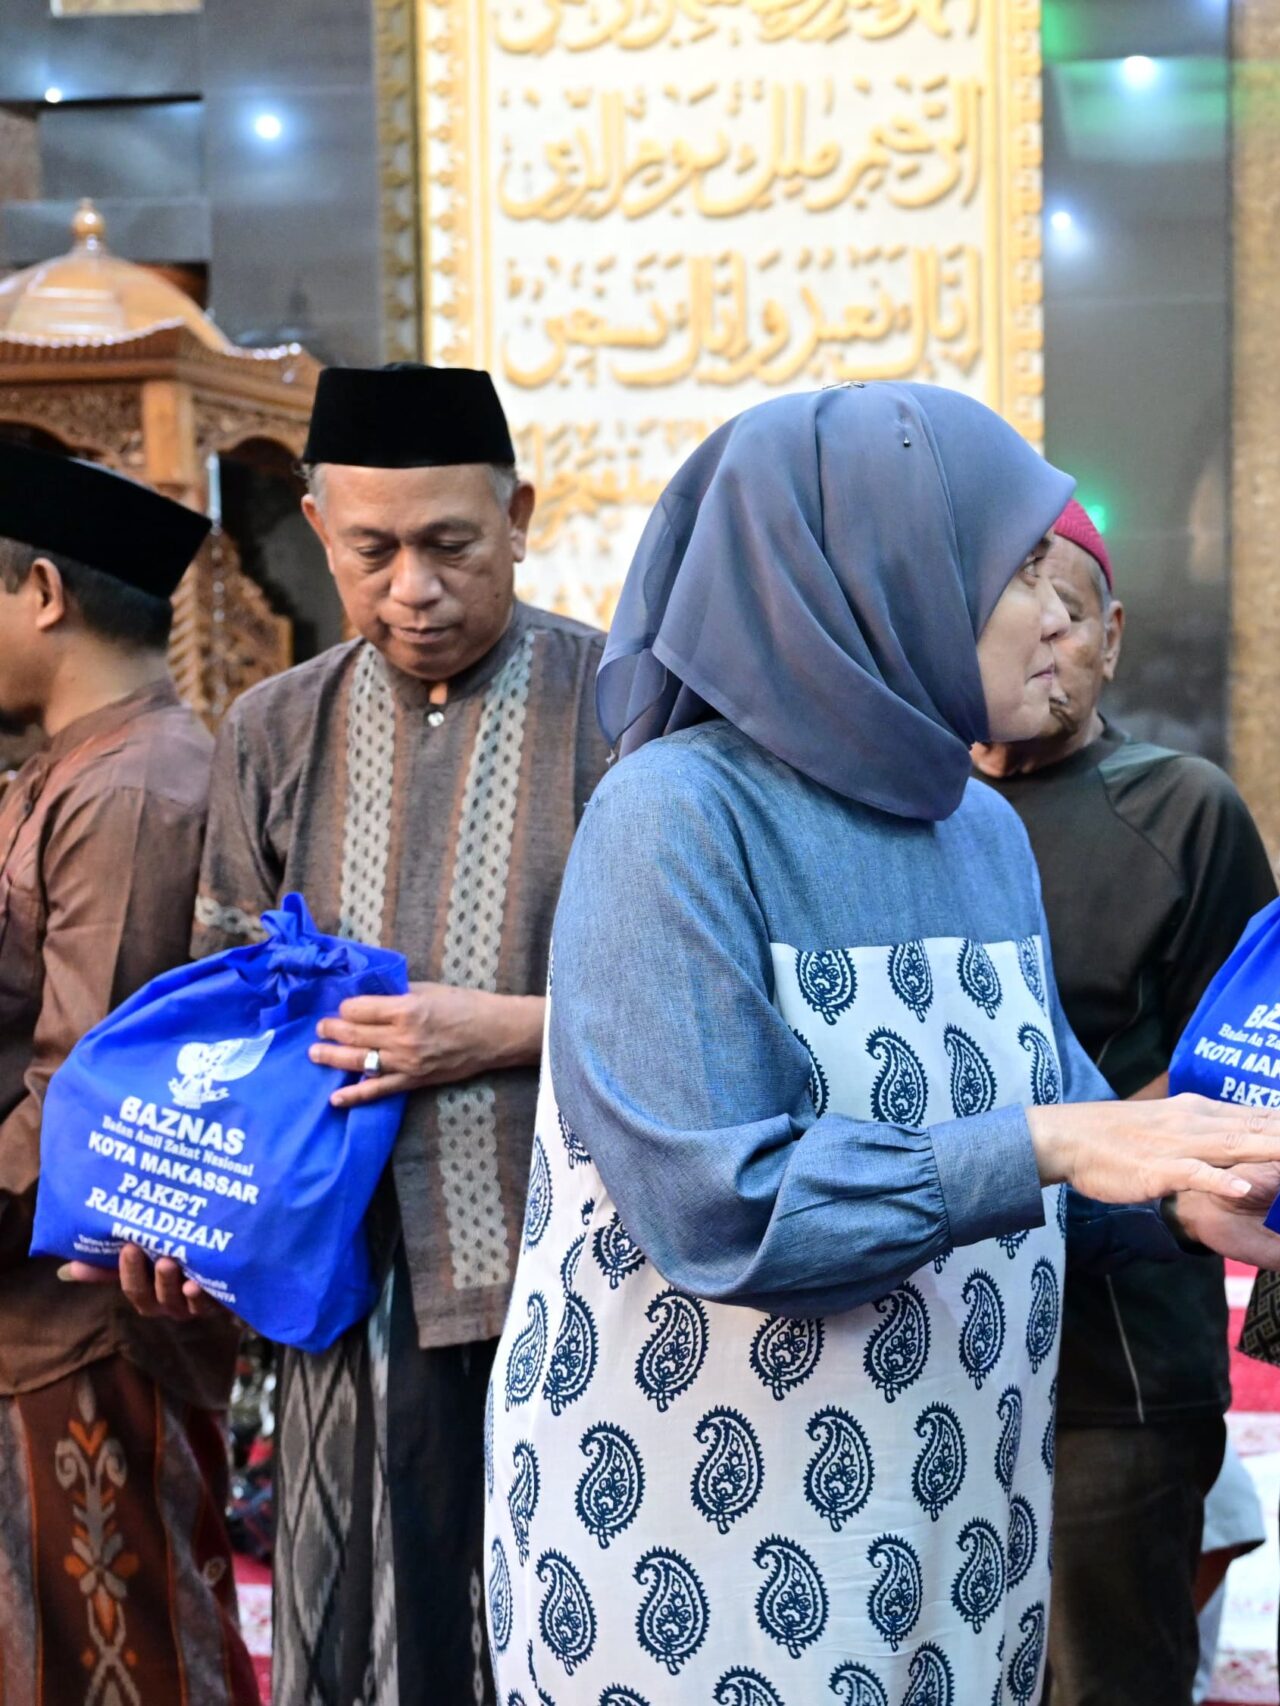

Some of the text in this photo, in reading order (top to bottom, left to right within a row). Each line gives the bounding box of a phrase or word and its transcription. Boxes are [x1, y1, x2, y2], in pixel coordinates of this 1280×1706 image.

[1194, 1036, 1242, 1067] KOTA
[102, 1115, 255, 1177] Badan Amil Zakat Nasional
[119, 1095, 246, 1156] BAZNAS
[88, 1130, 260, 1205] KOTA MAKASSAR
[117, 1172, 208, 1217] PAKET
[84, 1186, 234, 1252] RAMADHAN
[111, 1221, 188, 1264] MULIA
